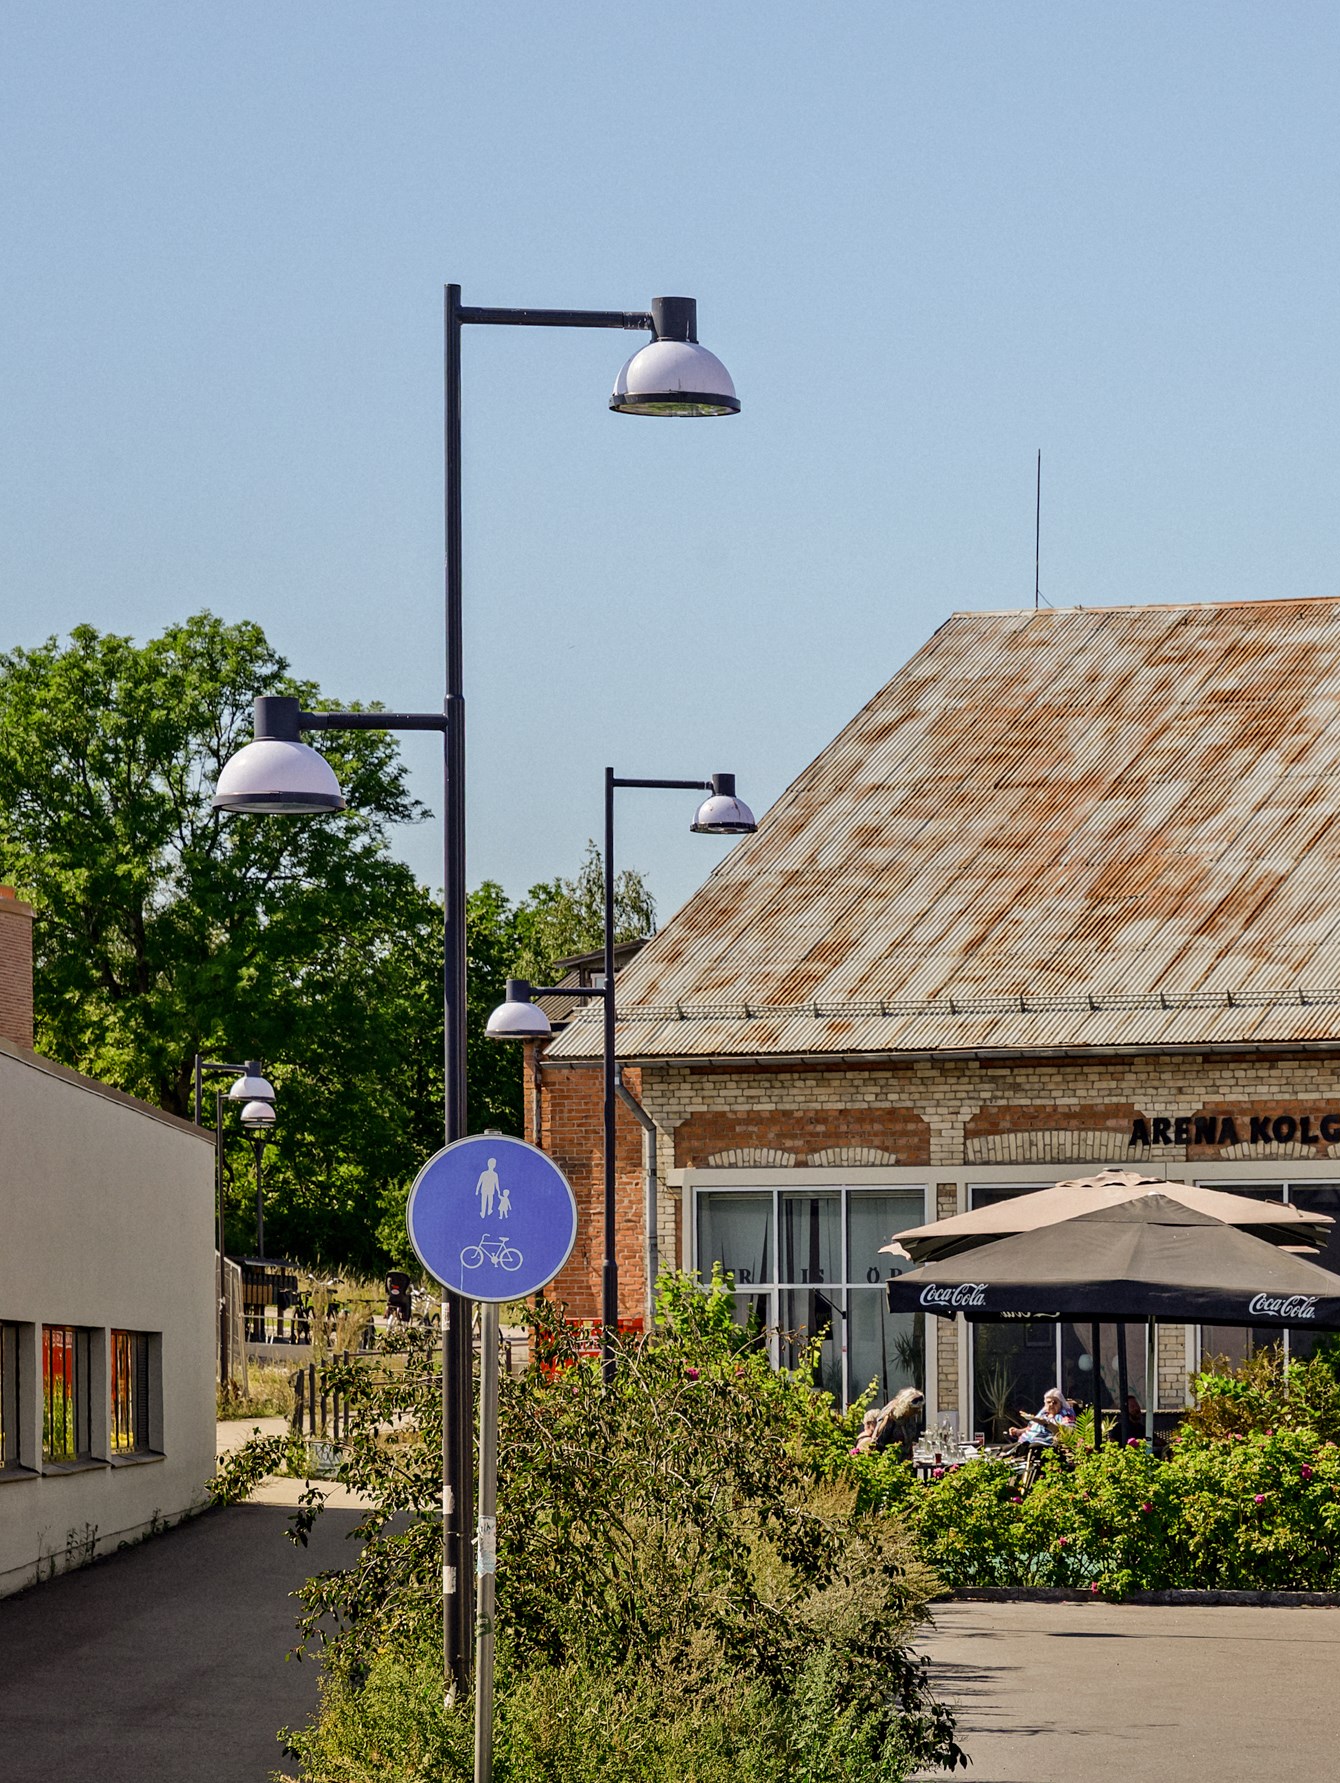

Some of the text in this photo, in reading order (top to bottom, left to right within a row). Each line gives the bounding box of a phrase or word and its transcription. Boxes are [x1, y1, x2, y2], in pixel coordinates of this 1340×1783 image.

[1128, 1115, 1239, 1146] ARENA
[919, 1283, 989, 1306] Coca-Cola
[1248, 1292, 1319, 1319] Coca-Cola
